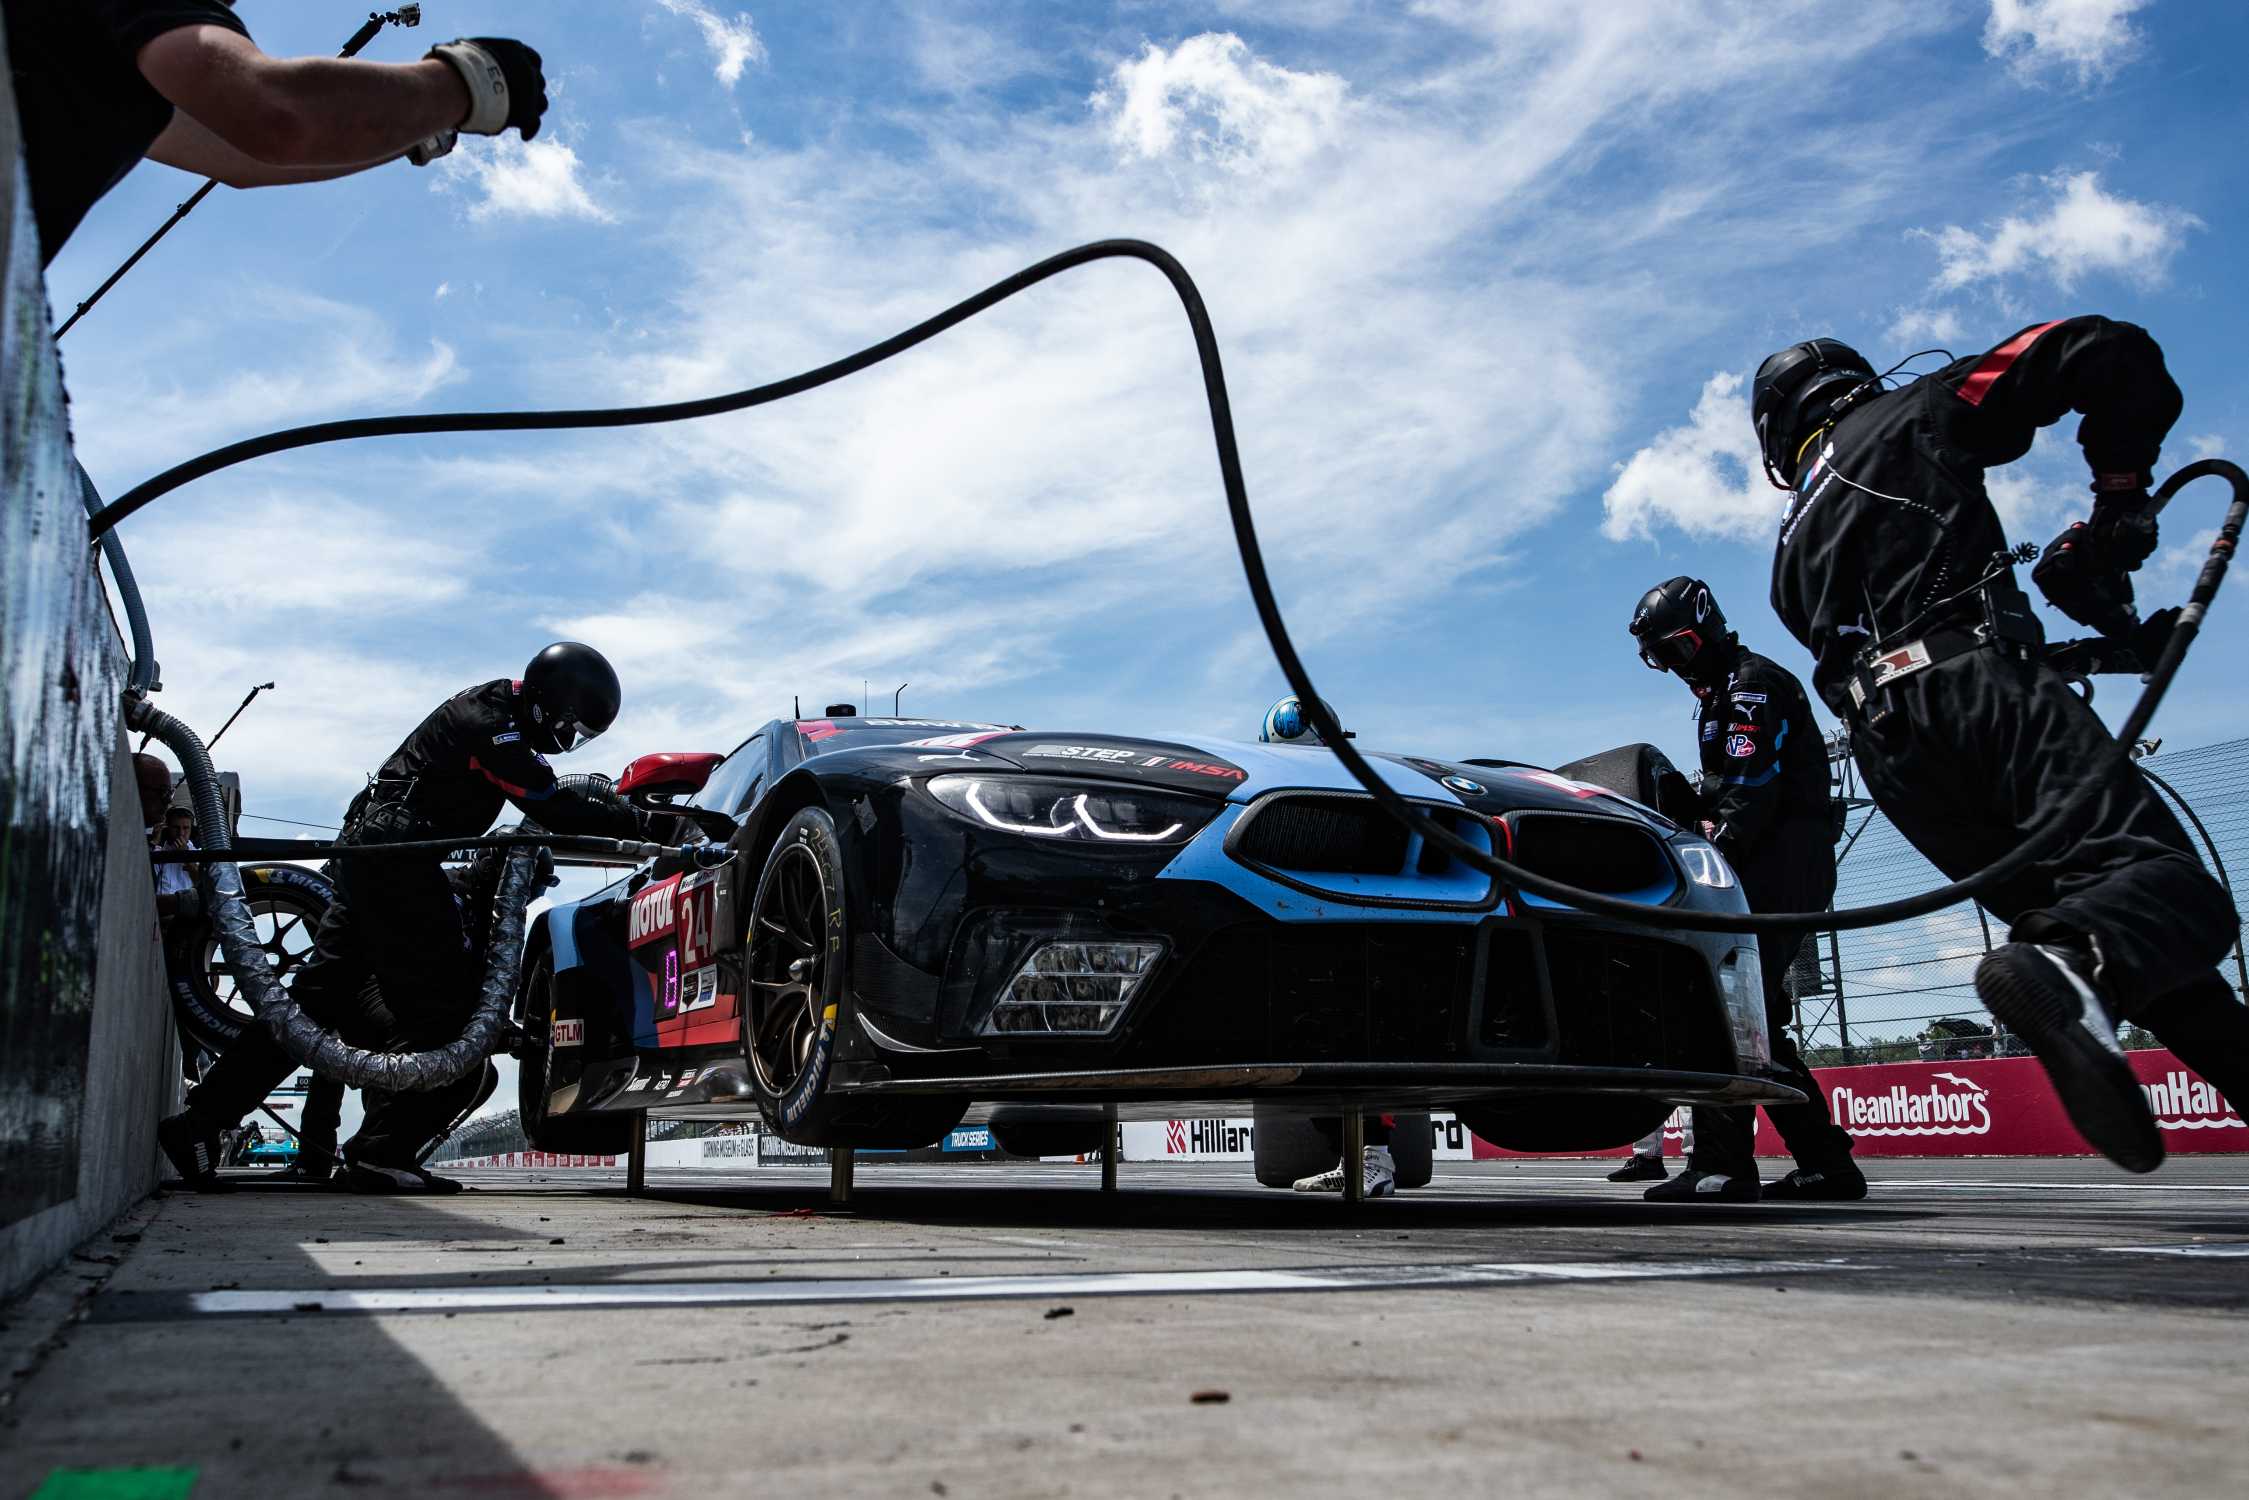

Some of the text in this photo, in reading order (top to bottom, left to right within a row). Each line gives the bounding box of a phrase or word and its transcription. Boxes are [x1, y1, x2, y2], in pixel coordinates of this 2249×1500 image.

[1060, 746, 1136, 760] STEP
[629, 882, 676, 943] MOTUL
[681, 888, 709, 965] 24
[555, 1021, 583, 1042] GTLM
[951, 1129, 989, 1147] TRUCK SERIES
[1191, 1119, 1254, 1154] Hilliar
